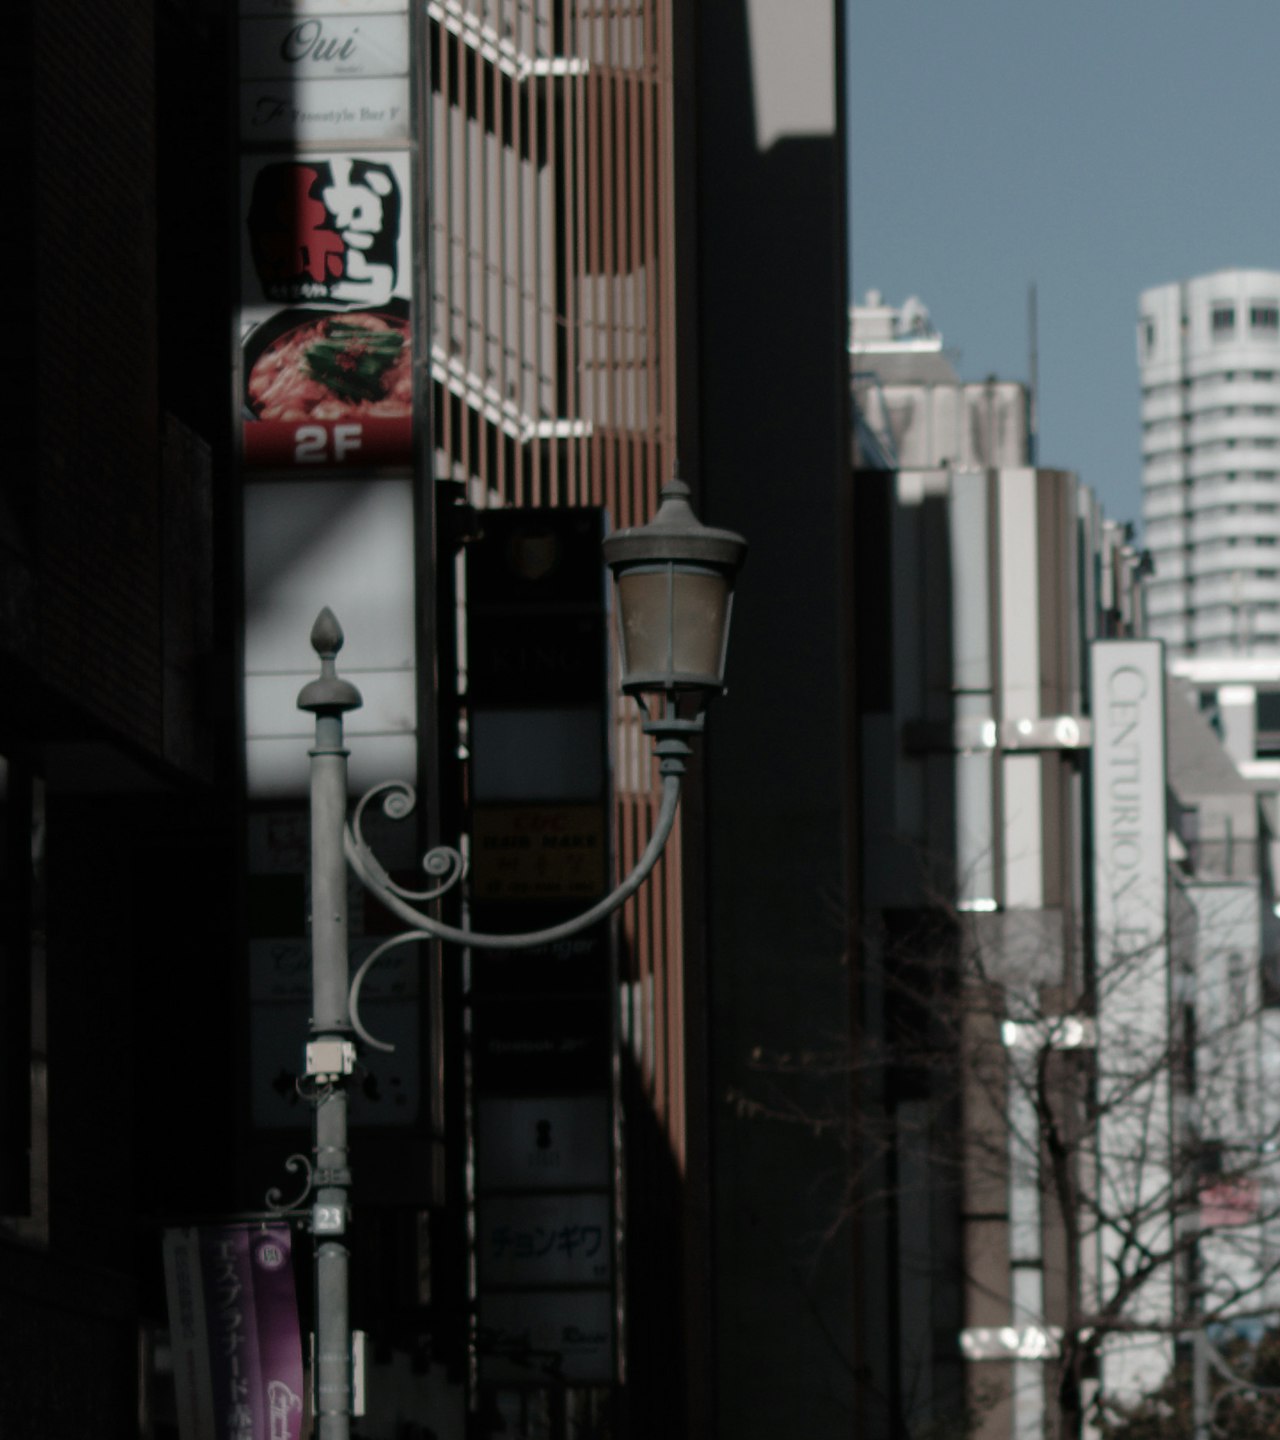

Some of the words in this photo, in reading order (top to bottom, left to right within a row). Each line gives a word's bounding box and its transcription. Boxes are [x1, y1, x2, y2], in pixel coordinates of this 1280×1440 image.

[279, 18, 360, 63] Oui
[294, 424, 363, 464] 2F
[319, 1207, 342, 1227] 23
